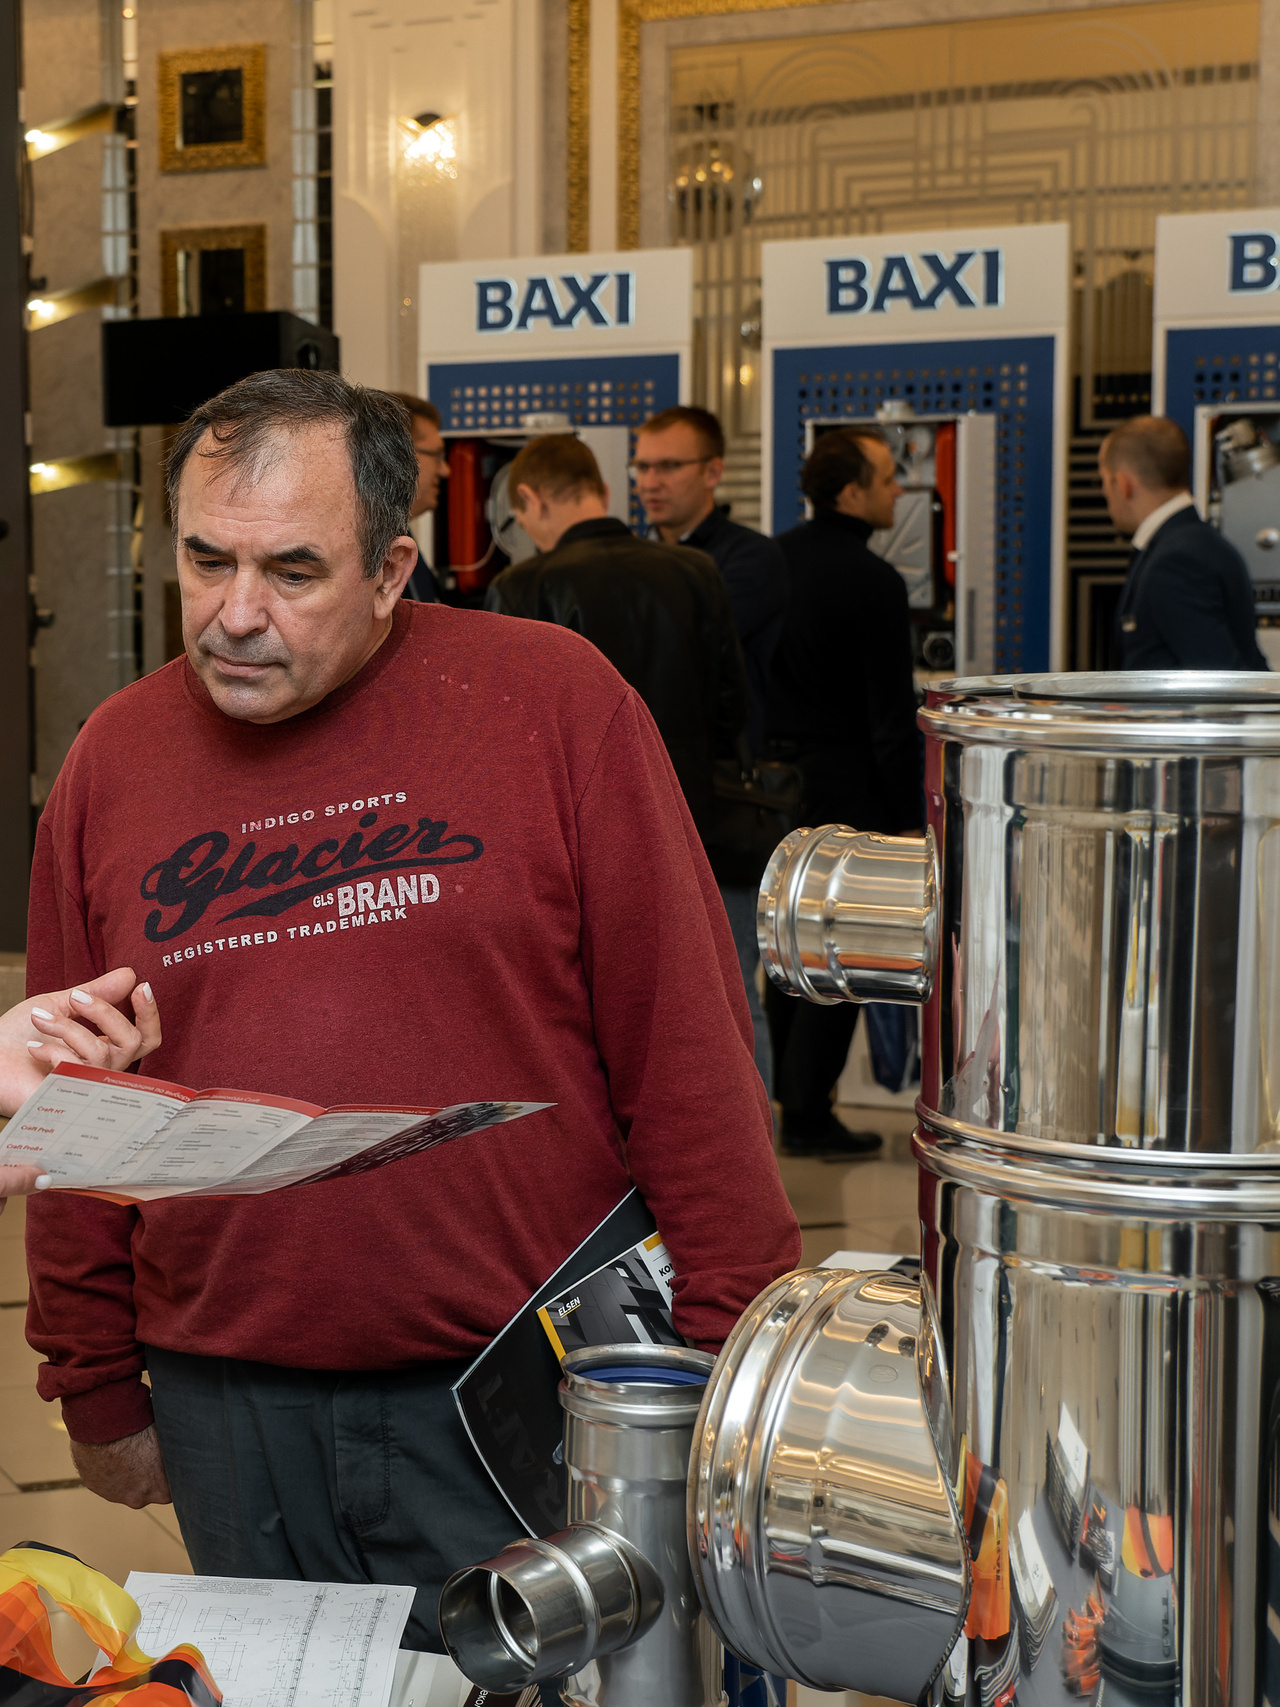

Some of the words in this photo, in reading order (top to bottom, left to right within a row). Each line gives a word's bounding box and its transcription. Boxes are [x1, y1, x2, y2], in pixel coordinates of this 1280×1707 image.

[474, 270, 636, 335] BAXI
[824, 247, 1005, 316] BAXI
[241, 809, 316, 834] INDIGO
[324, 791, 408, 817] SPORTS
[140, 812, 484, 942] Glacier
[312, 893, 335, 909] GLS
[337, 873, 440, 917] BRAND
[162, 930, 278, 967] REGISTERED
[287, 907, 408, 940] TRADEMARK
[558, 1296, 581, 1317] ELSEN
